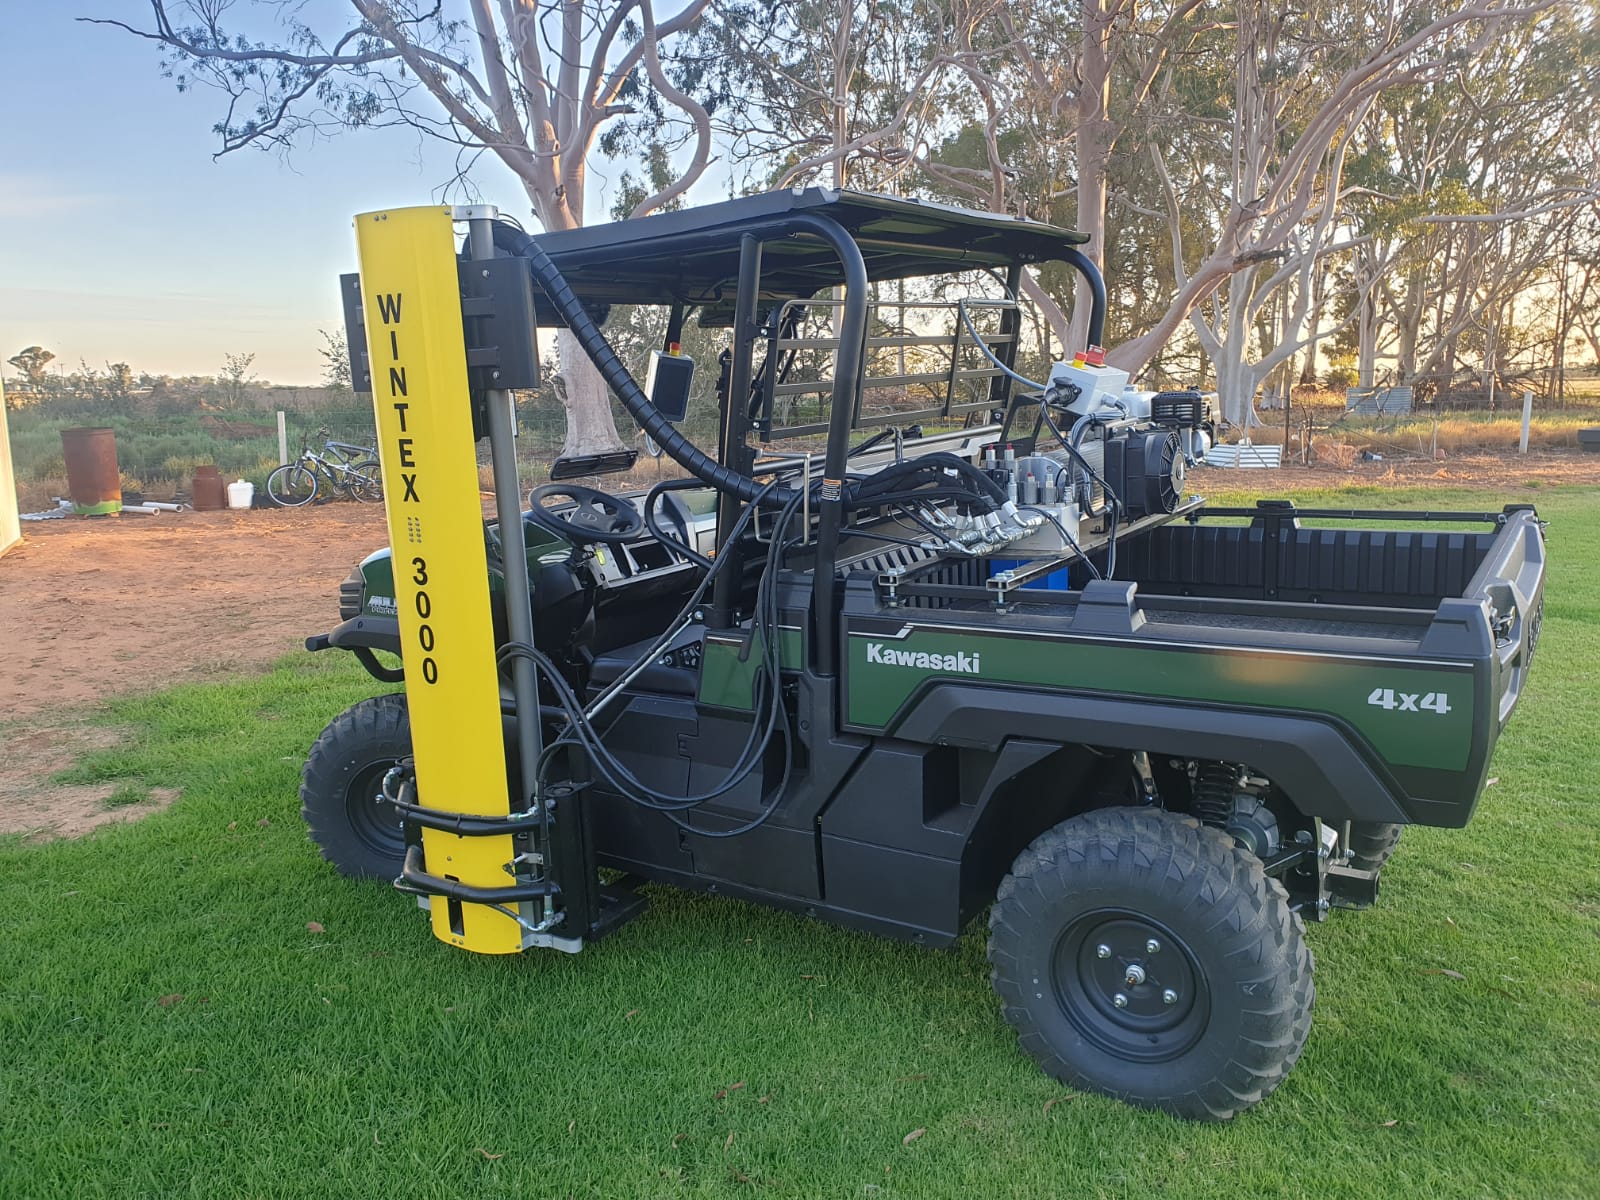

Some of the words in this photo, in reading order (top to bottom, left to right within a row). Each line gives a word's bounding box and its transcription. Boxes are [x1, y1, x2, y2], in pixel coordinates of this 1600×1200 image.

[377, 293, 420, 502] WINTEX
[412, 557, 438, 685] 3000
[866, 643, 980, 674] Kawasaki
[1367, 688, 1452, 714] 4x4
